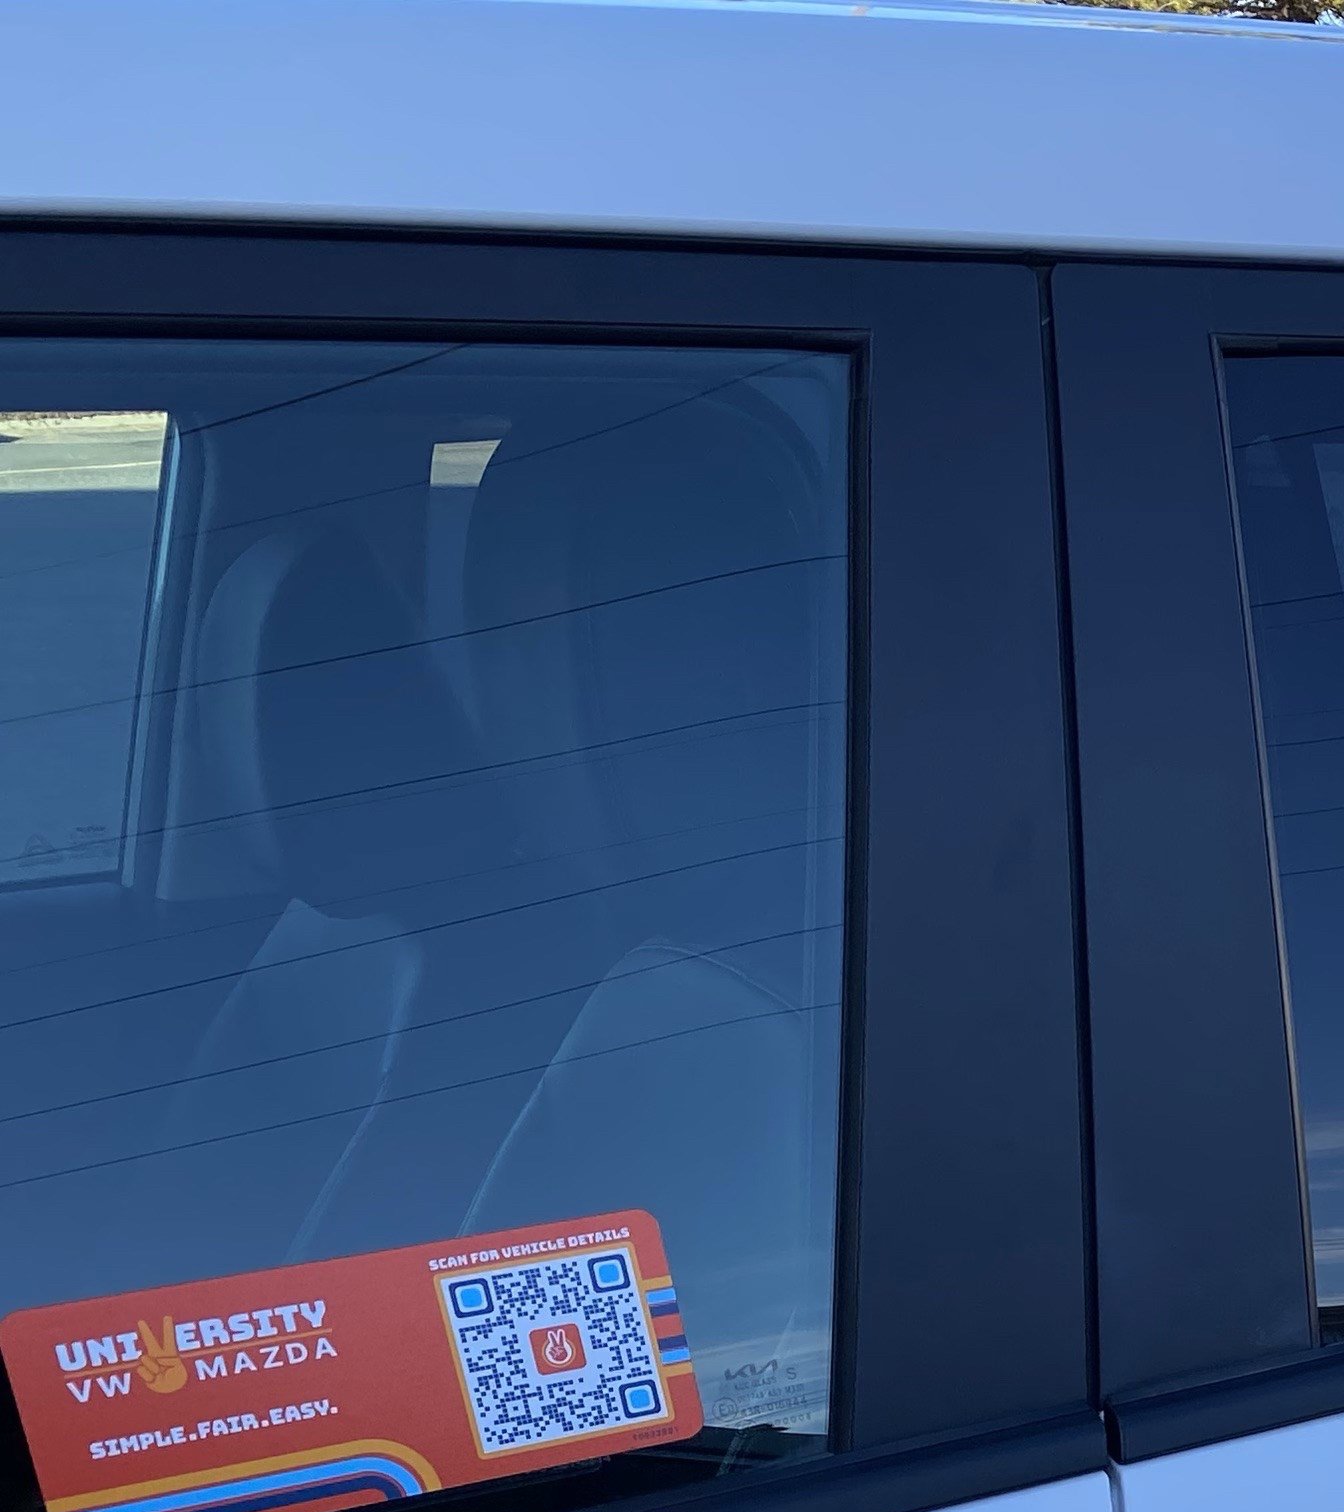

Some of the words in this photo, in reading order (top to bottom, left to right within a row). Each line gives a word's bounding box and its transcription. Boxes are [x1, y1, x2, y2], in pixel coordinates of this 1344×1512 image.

[428, 1254, 468, 1271] SCAN
[471, 1248, 499, 1264] FOR
[501, 1238, 566, 1258] VEHICLE
[568, 1227, 630, 1248] DETAILS
[55, 1300, 327, 1372] UNIVERSITY
[66, 1372, 131, 1403] VW
[194, 1337, 338, 1381] MAZDA
[89, 1399, 338, 1460] SIMPLE.FAIR.EASY.
